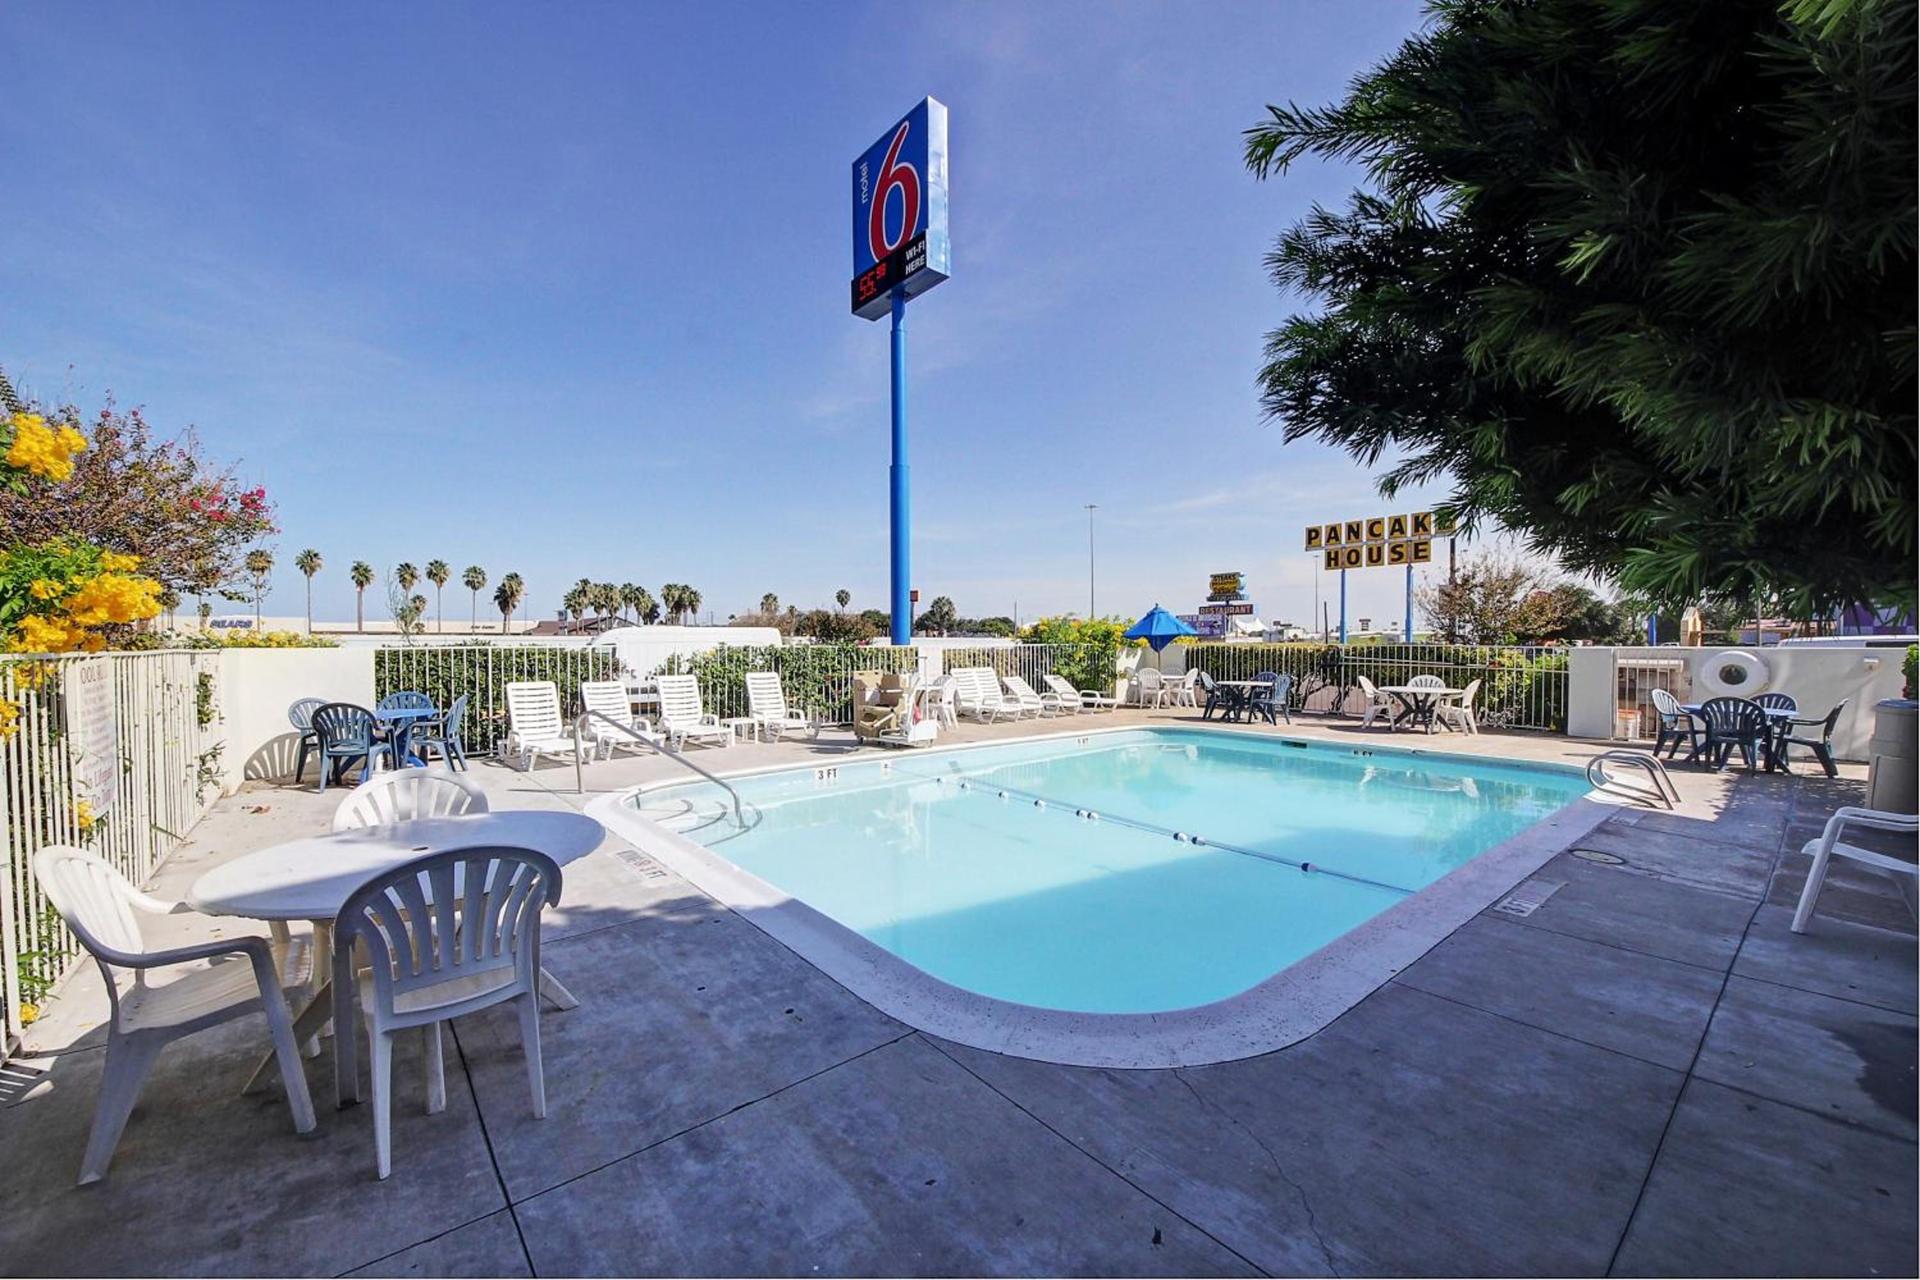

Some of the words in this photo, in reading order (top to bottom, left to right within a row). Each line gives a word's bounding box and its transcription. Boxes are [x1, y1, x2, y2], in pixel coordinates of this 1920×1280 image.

[859, 161, 869, 205] motel
[869, 121, 921, 264] 6
[905, 240, 926, 261] WI-FI
[905, 254, 926, 276] HERE
[1307, 512, 1454, 546] PANCAK
[1326, 541, 1430, 568] HOUSE
[1200, 604, 1251, 616] RESTAURANT
[818, 769, 824, 780] 3
[827, 768, 838, 779] FT
